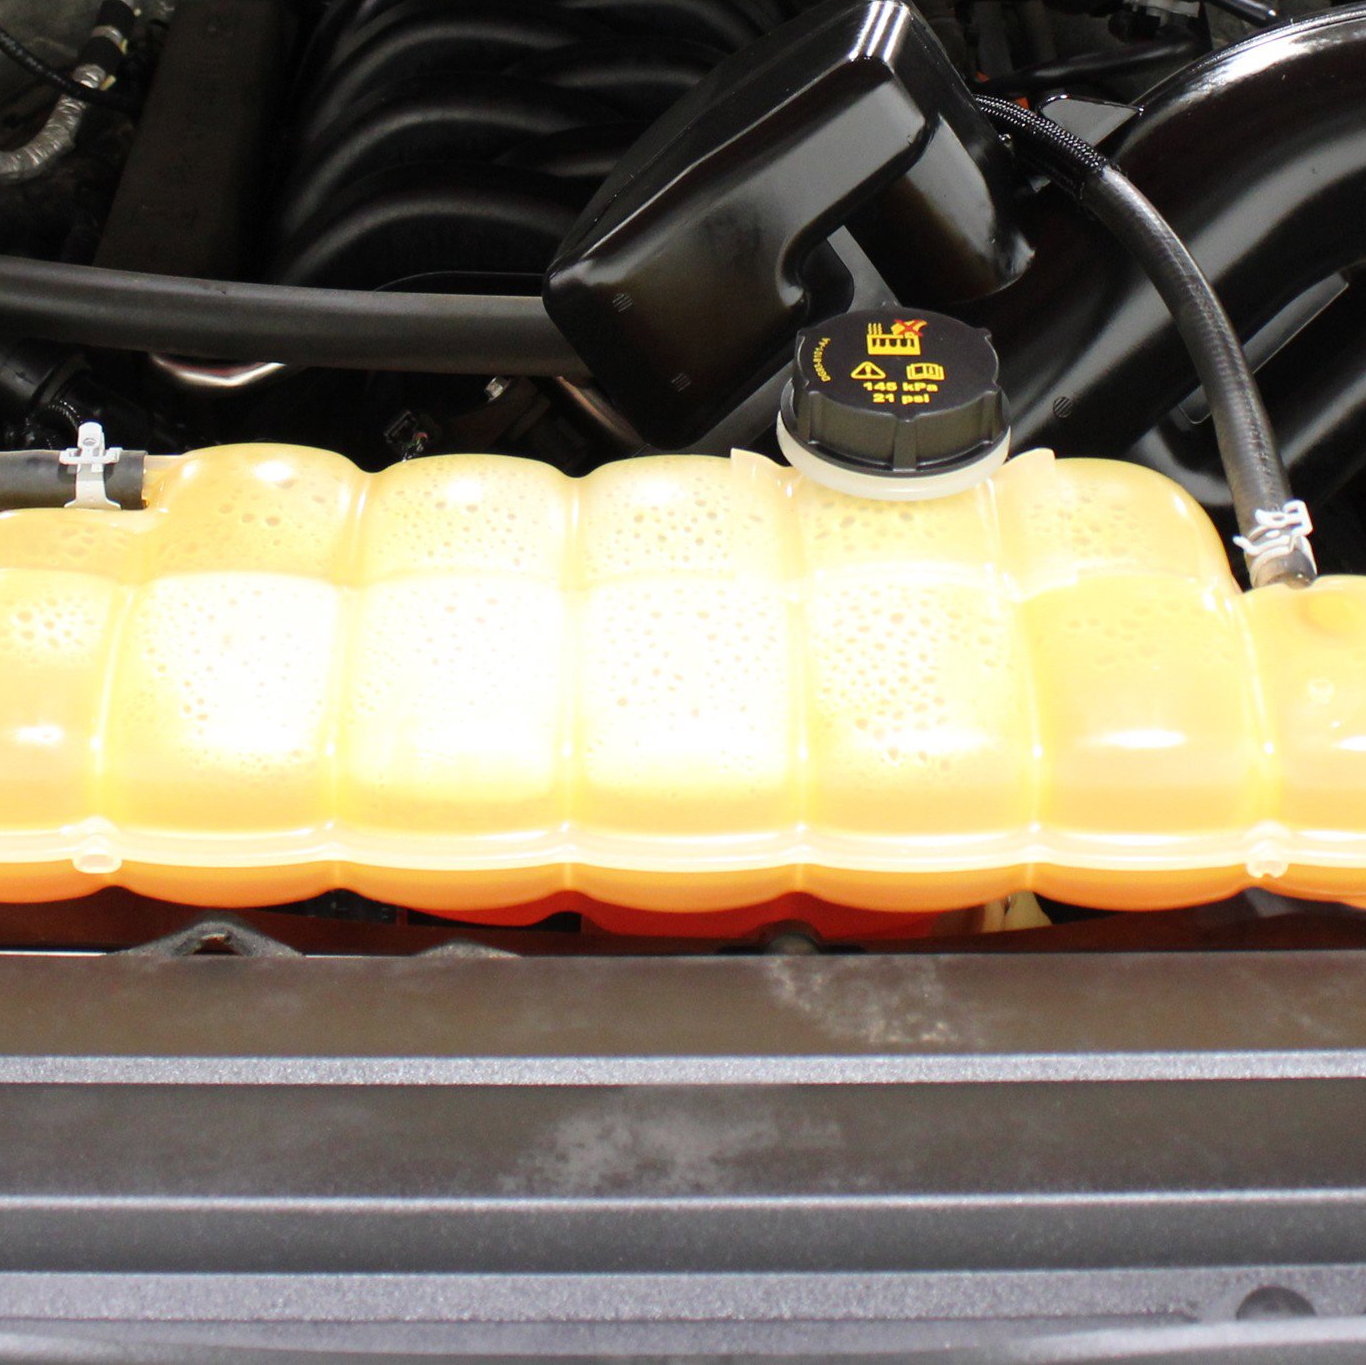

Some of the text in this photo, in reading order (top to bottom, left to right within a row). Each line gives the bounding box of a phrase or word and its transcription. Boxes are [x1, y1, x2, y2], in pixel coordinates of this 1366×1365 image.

[863, 381, 939, 392] 145 kPa
[872, 393, 931, 405] 21 psi
